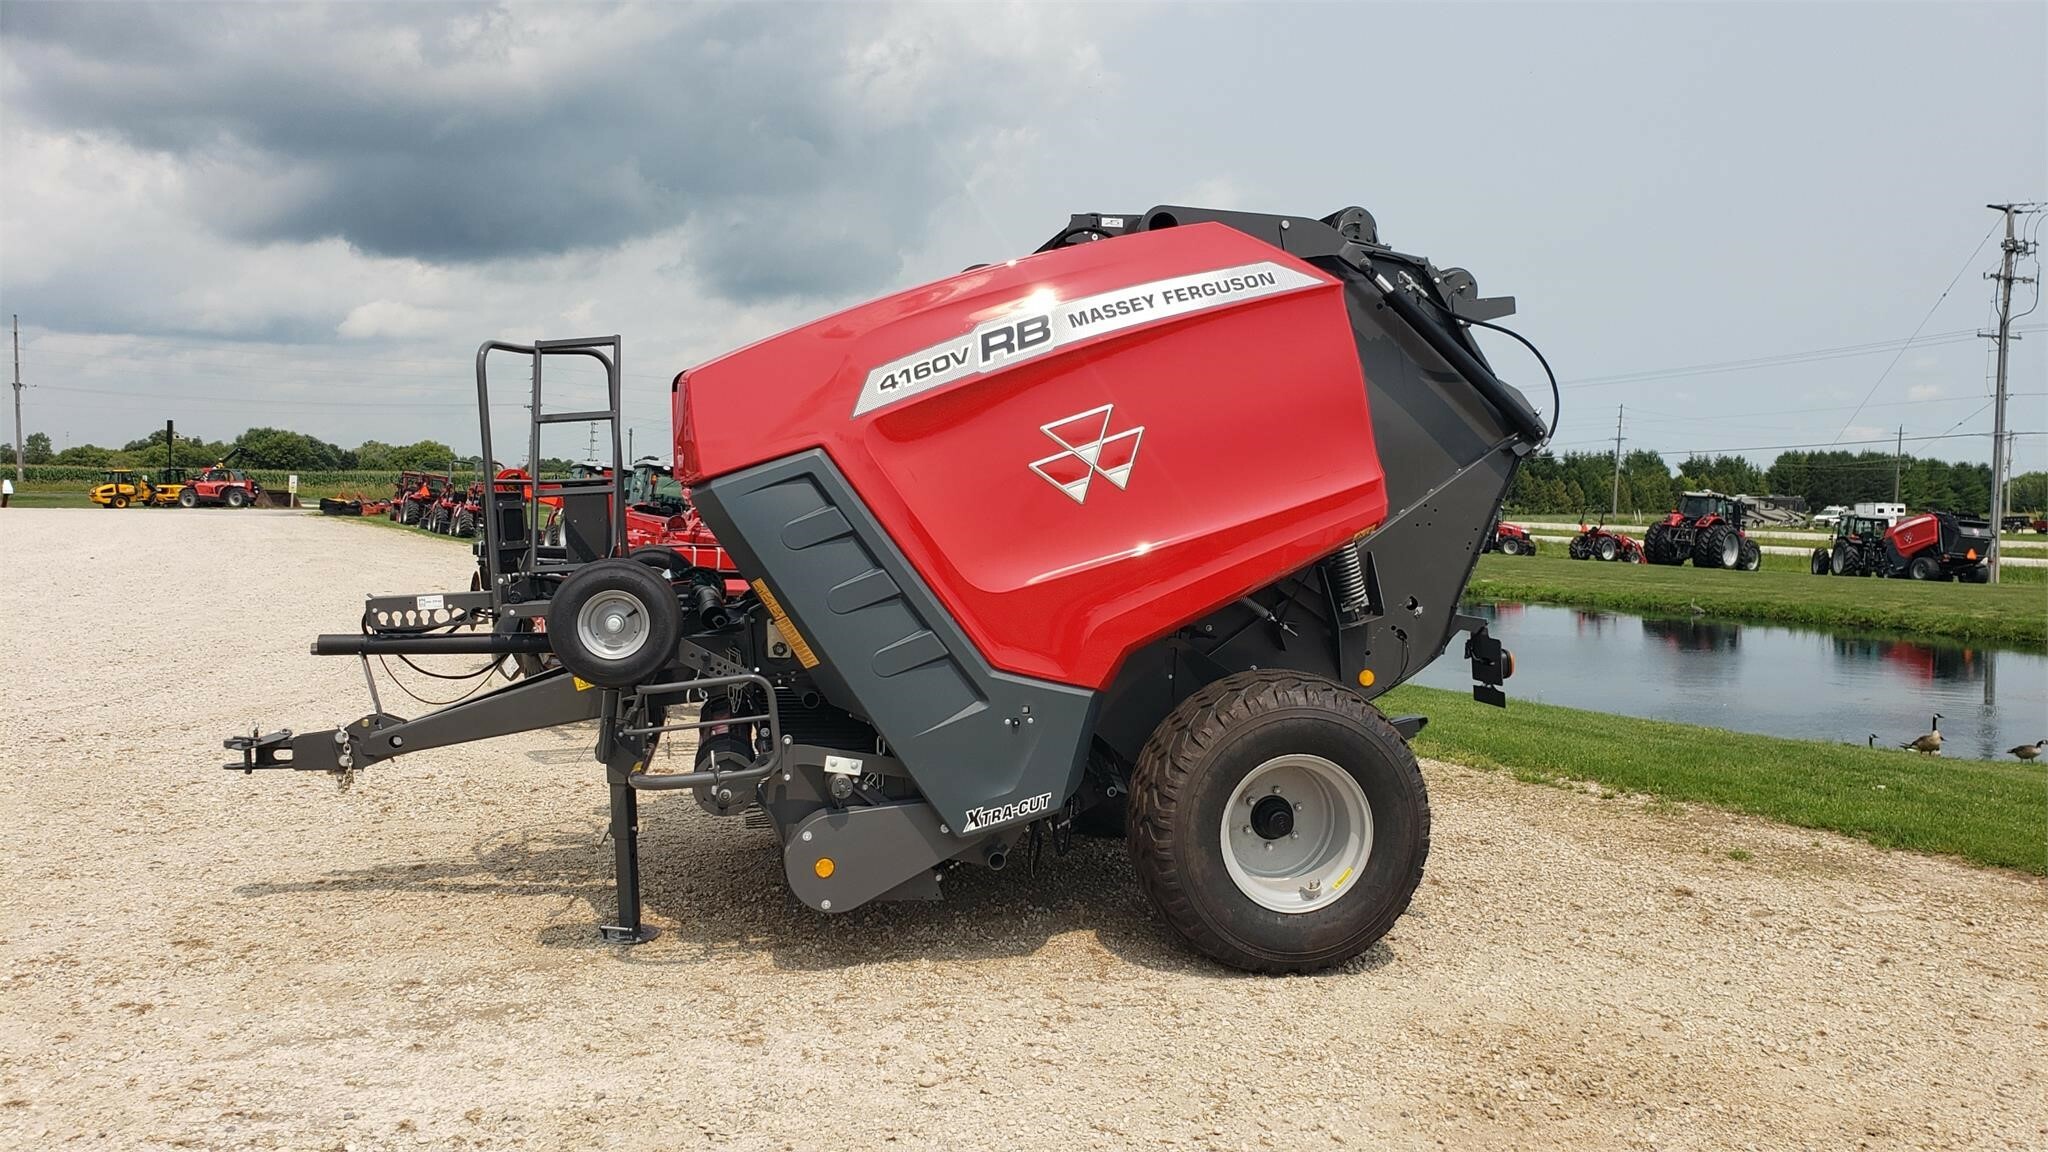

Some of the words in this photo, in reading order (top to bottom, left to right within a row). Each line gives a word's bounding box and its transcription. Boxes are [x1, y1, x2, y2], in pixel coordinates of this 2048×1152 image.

[880, 346, 969, 391] 4160V
[980, 314, 1052, 363] RB
[1067, 294, 1155, 329] MASSEY
[1162, 271, 1276, 305] FERGUSON
[963, 792, 1052, 833] XTRA-CUT
